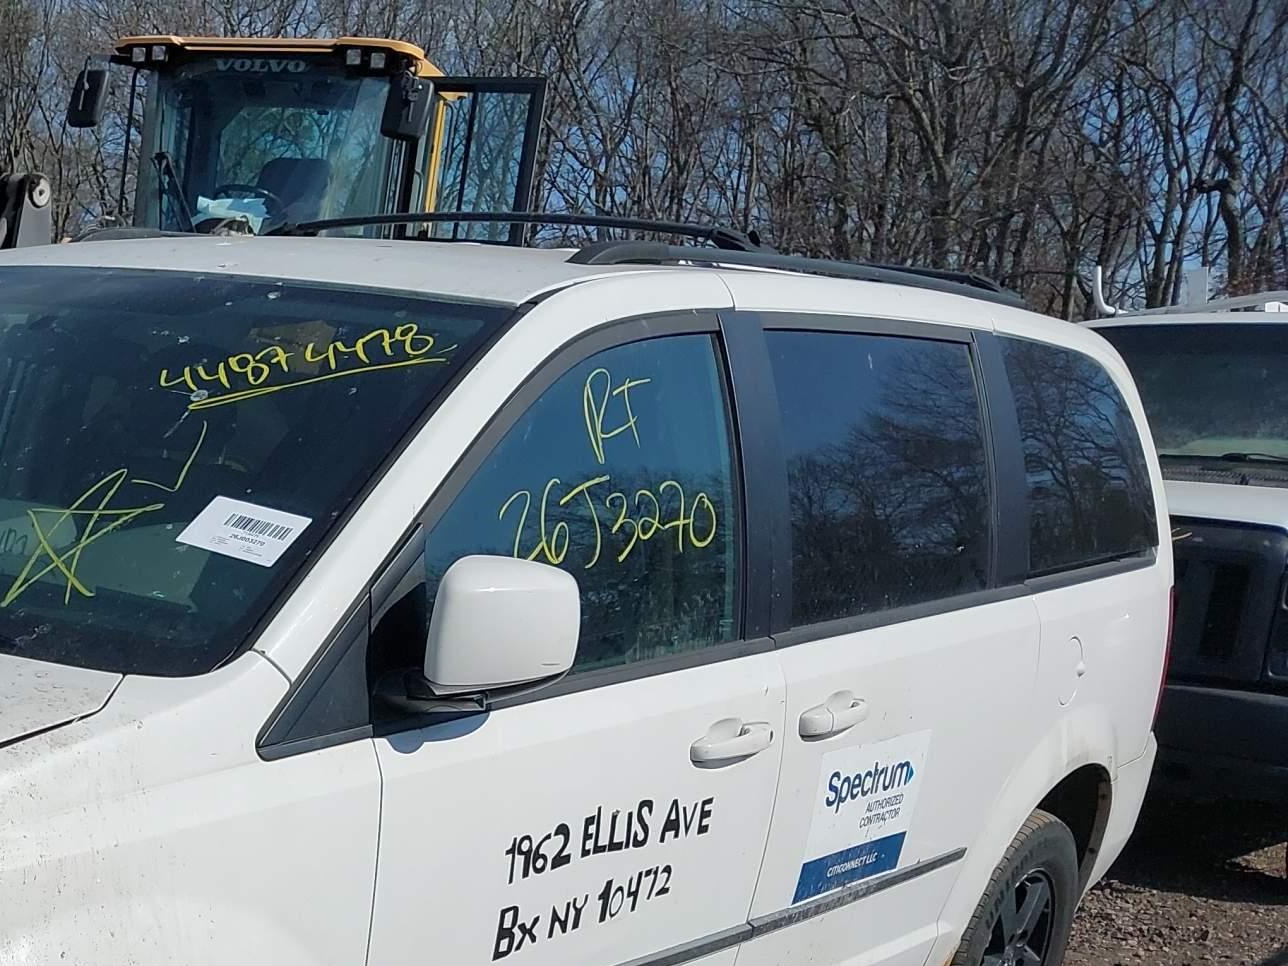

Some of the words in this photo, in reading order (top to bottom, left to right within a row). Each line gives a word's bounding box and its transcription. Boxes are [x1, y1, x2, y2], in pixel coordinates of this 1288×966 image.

[215, 58, 310, 73] VOLVO
[161, 323, 434, 391] 44874478
[825, 760, 912, 814] Spectrum
[865, 793, 904, 814] AUTHORIZED
[859, 807, 901, 829] CONTRACTOR
[505, 822, 572, 885] 1962
[580, 799, 654, 859] ELLIS
[658, 797, 715, 844] AVE
[866, 851, 879, 864] LLC
[547, 893, 589, 939] NY
[597, 864, 673, 924] 10472
